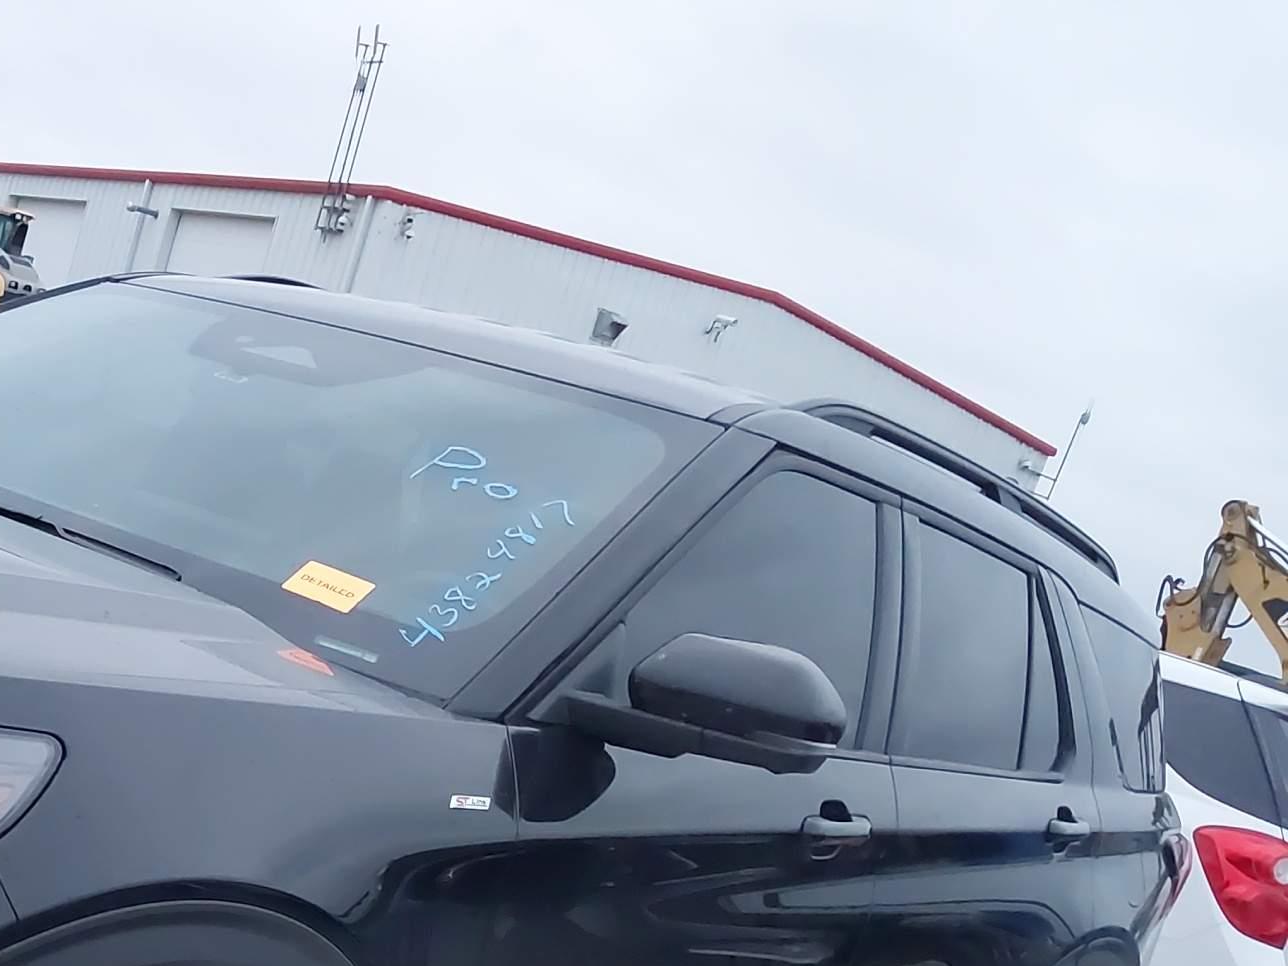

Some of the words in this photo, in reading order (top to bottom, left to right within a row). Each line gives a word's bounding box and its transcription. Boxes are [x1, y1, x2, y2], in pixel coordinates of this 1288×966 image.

[409, 445, 518, 500] Pro
[300, 573, 355, 599] DETAILED
[398, 498, 575, 647] 43824817
